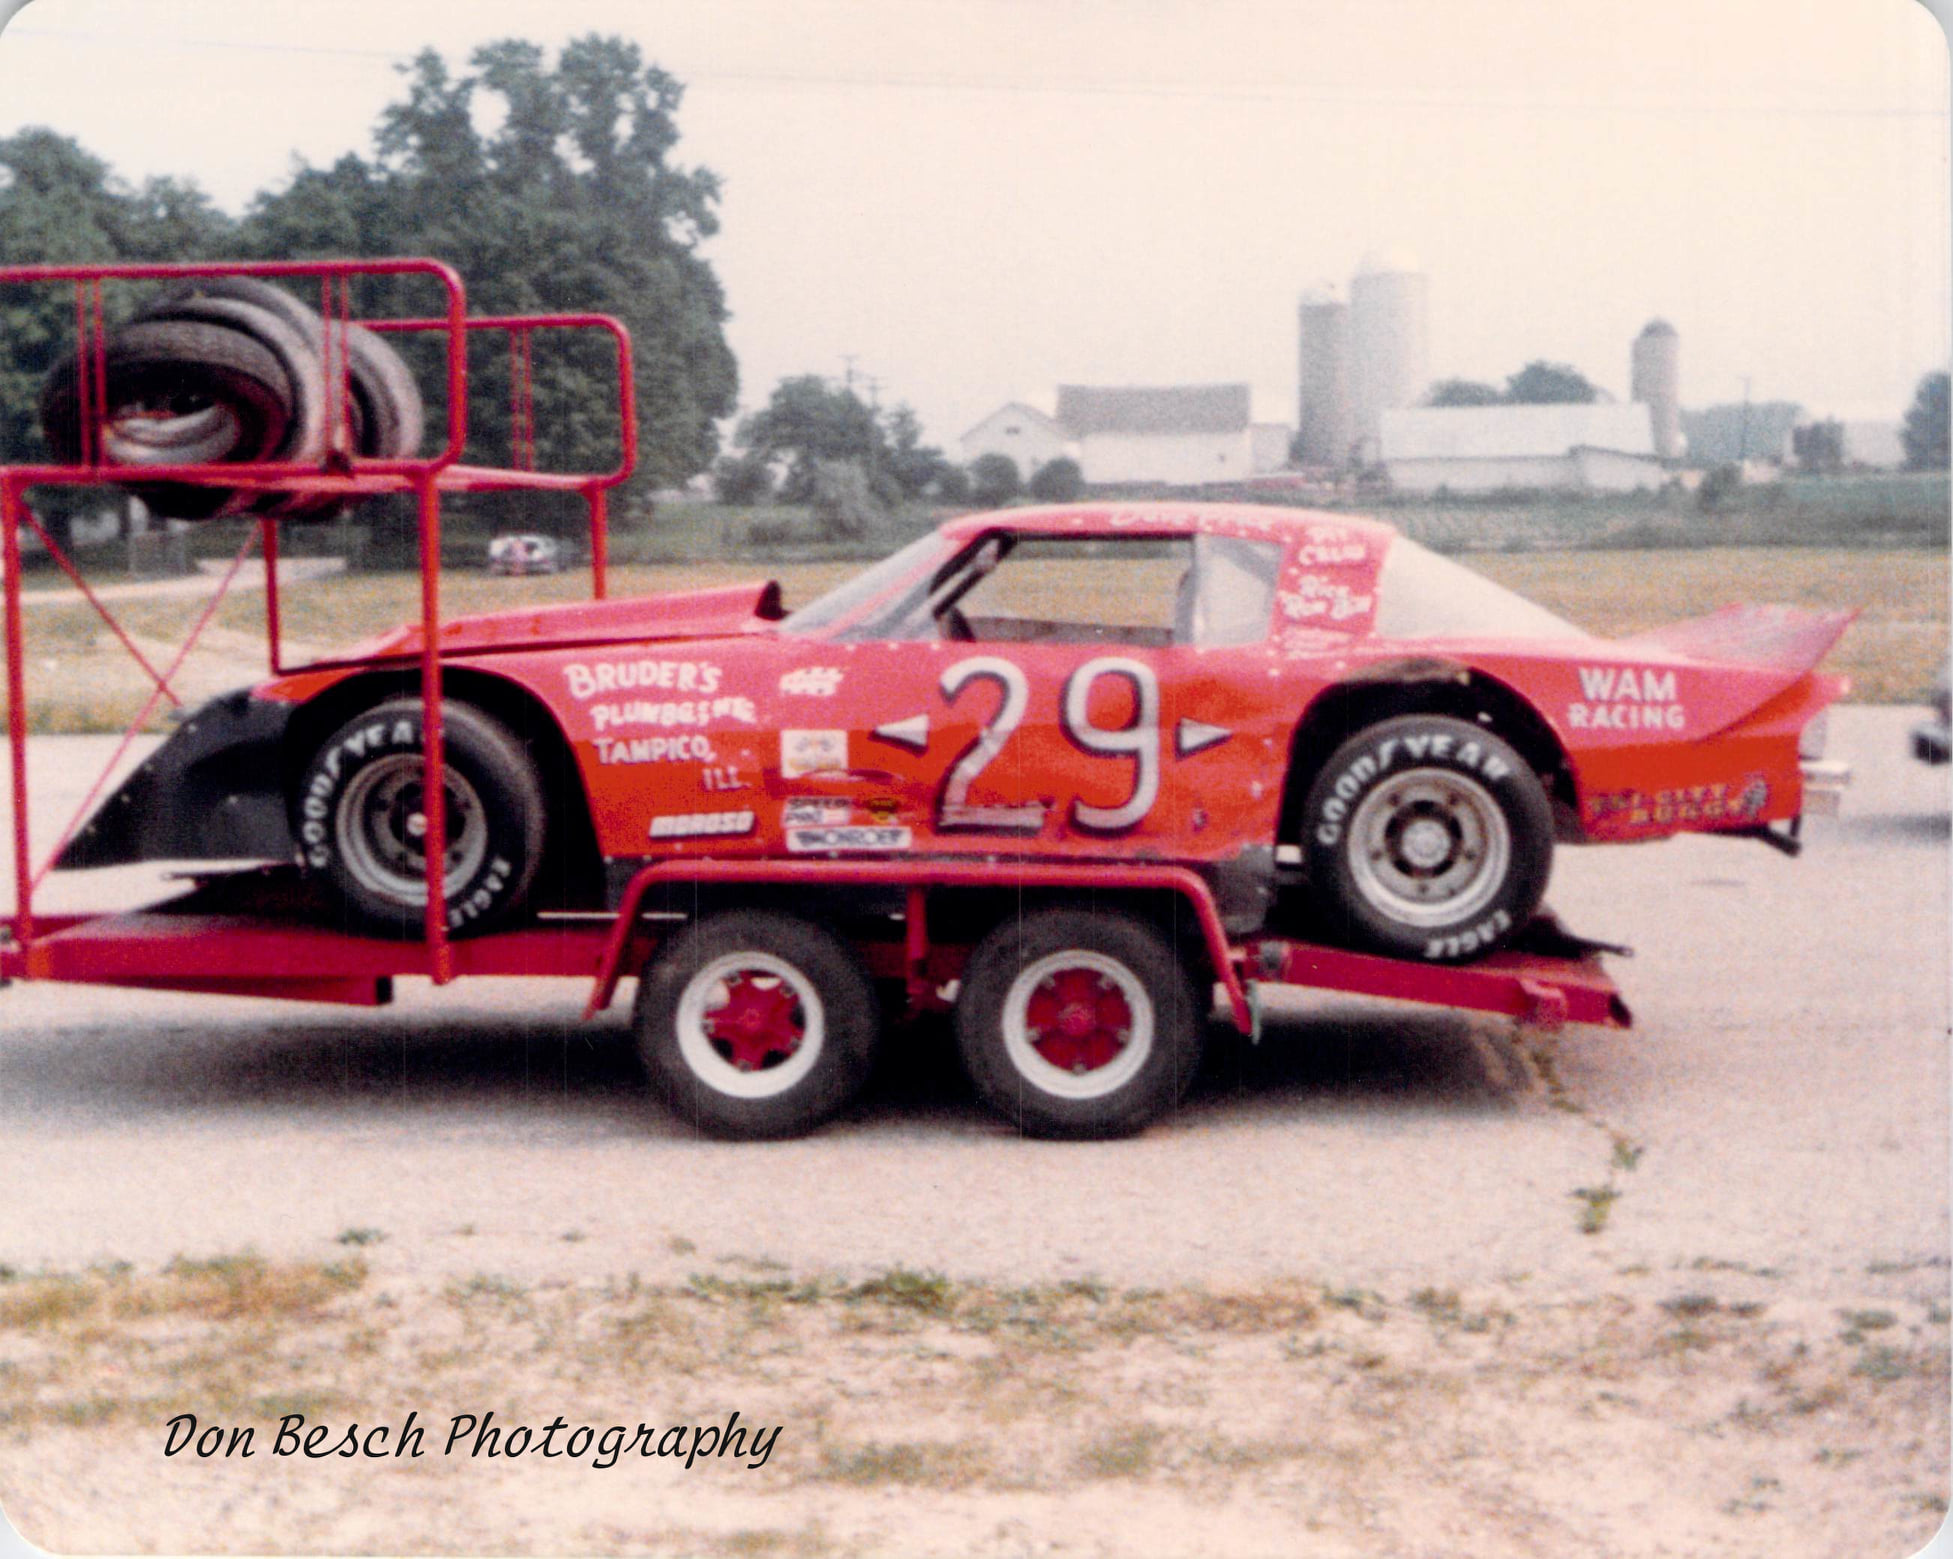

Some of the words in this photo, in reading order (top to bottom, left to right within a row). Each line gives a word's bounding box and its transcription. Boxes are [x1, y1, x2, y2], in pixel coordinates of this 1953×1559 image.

[565, 660, 722, 699] BRUDER'S
[1579, 667, 1677, 701] WAM
[1566, 702, 1686, 729] RACING
[937, 656, 1160, 836] 29
